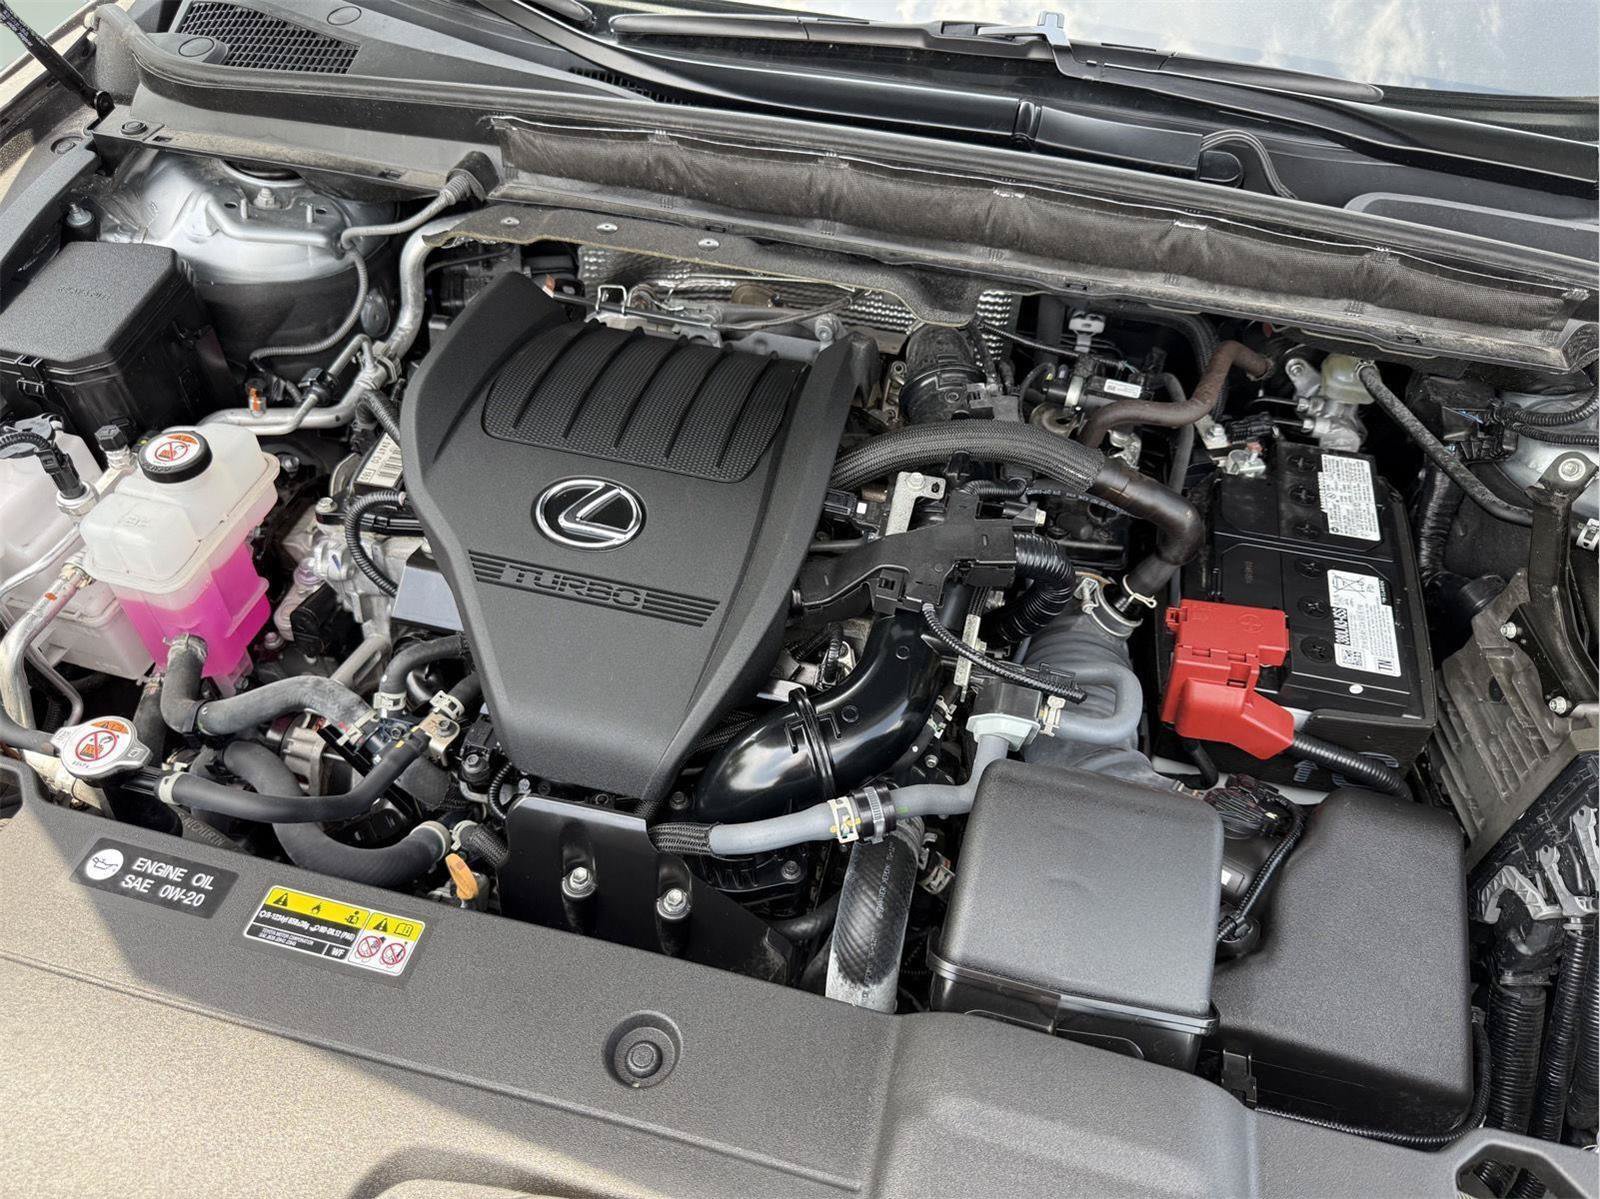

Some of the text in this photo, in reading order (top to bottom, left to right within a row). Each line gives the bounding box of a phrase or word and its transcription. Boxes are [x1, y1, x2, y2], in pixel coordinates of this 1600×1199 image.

[507, 564, 642, 607] TURBO
[132, 857, 215, 890] ENGINE OIL
[121, 874, 206, 907] SAE 0W-20
